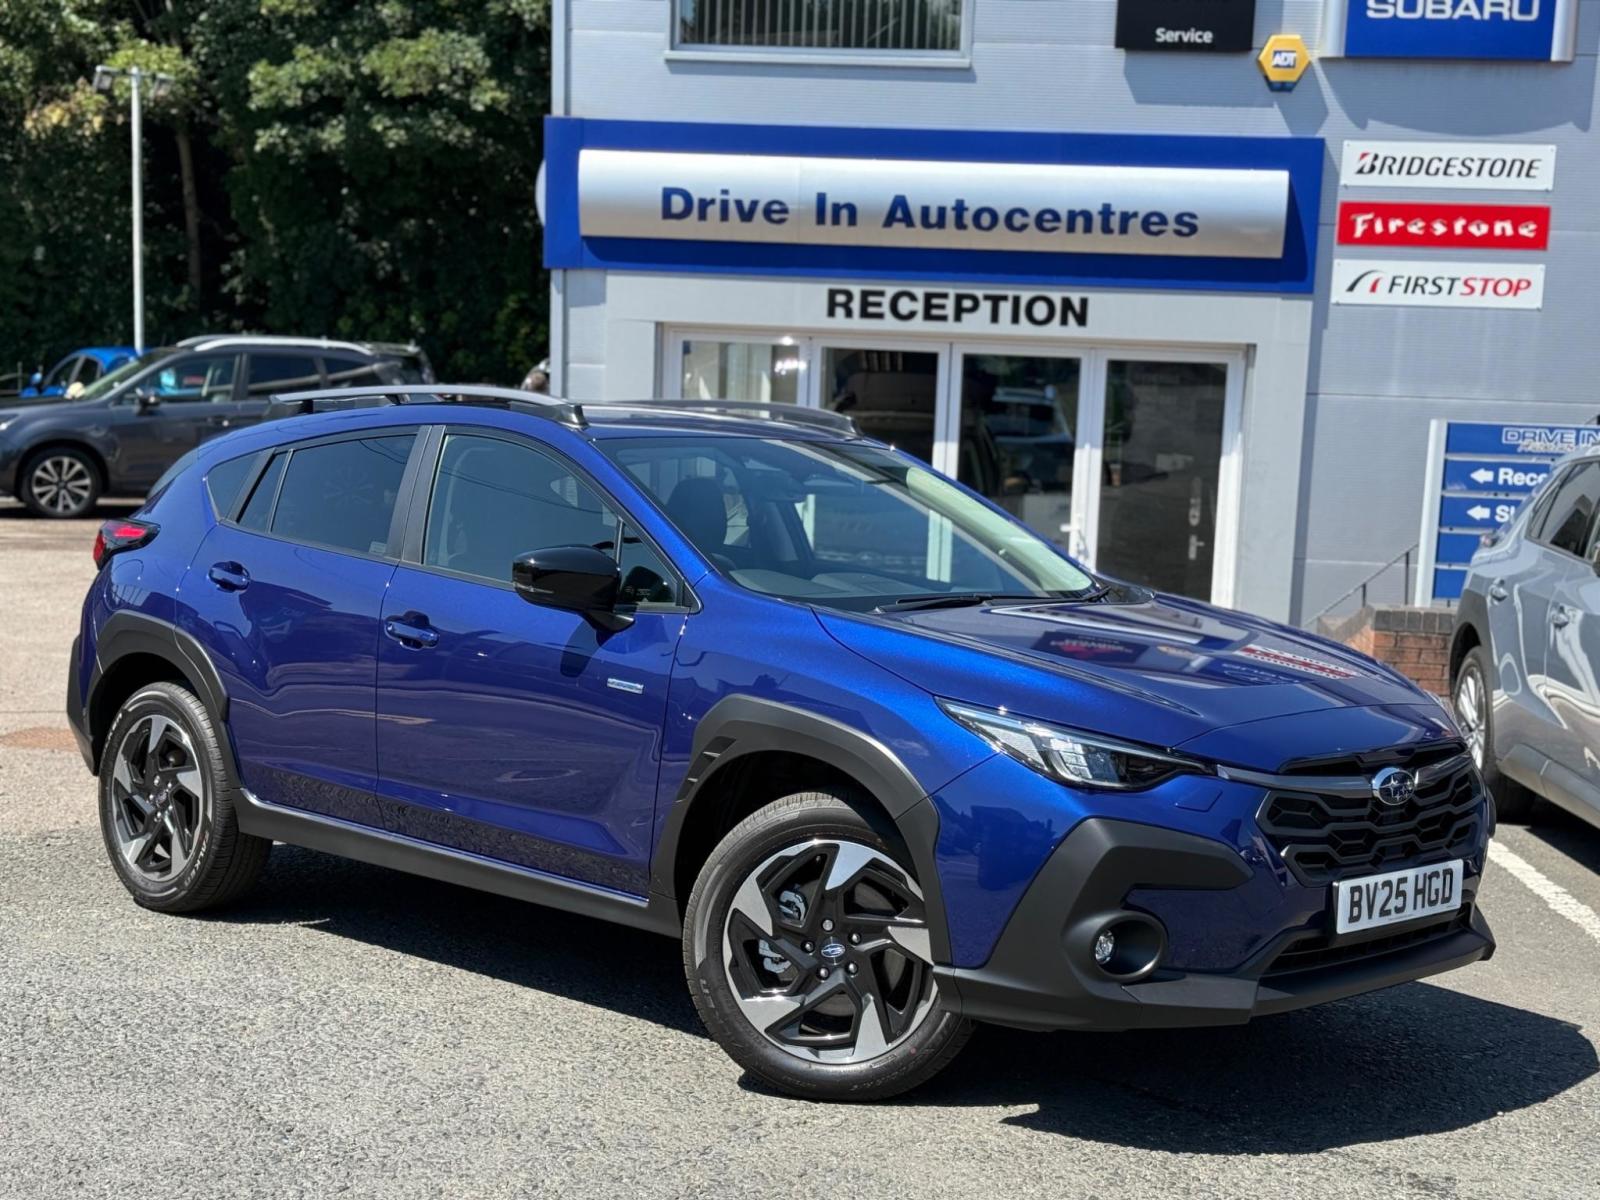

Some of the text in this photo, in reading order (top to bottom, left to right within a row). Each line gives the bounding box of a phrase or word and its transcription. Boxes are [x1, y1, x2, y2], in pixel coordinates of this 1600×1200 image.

[1366, 0, 1540, 21] SUBARU
[1155, 27, 1213, 43] Service
[1272, 52, 1296, 67] ADT
[1355, 152, 1542, 178] BRIDGESTONE
[661, 186, 1199, 237] Drive In Autocentres
[1351, 212, 1538, 238] Firestone
[826, 288, 1089, 327] RECEPTION
[1502, 427, 1577, 445] DRIVE
[1348, 868, 1454, 924] BV25 HGD
